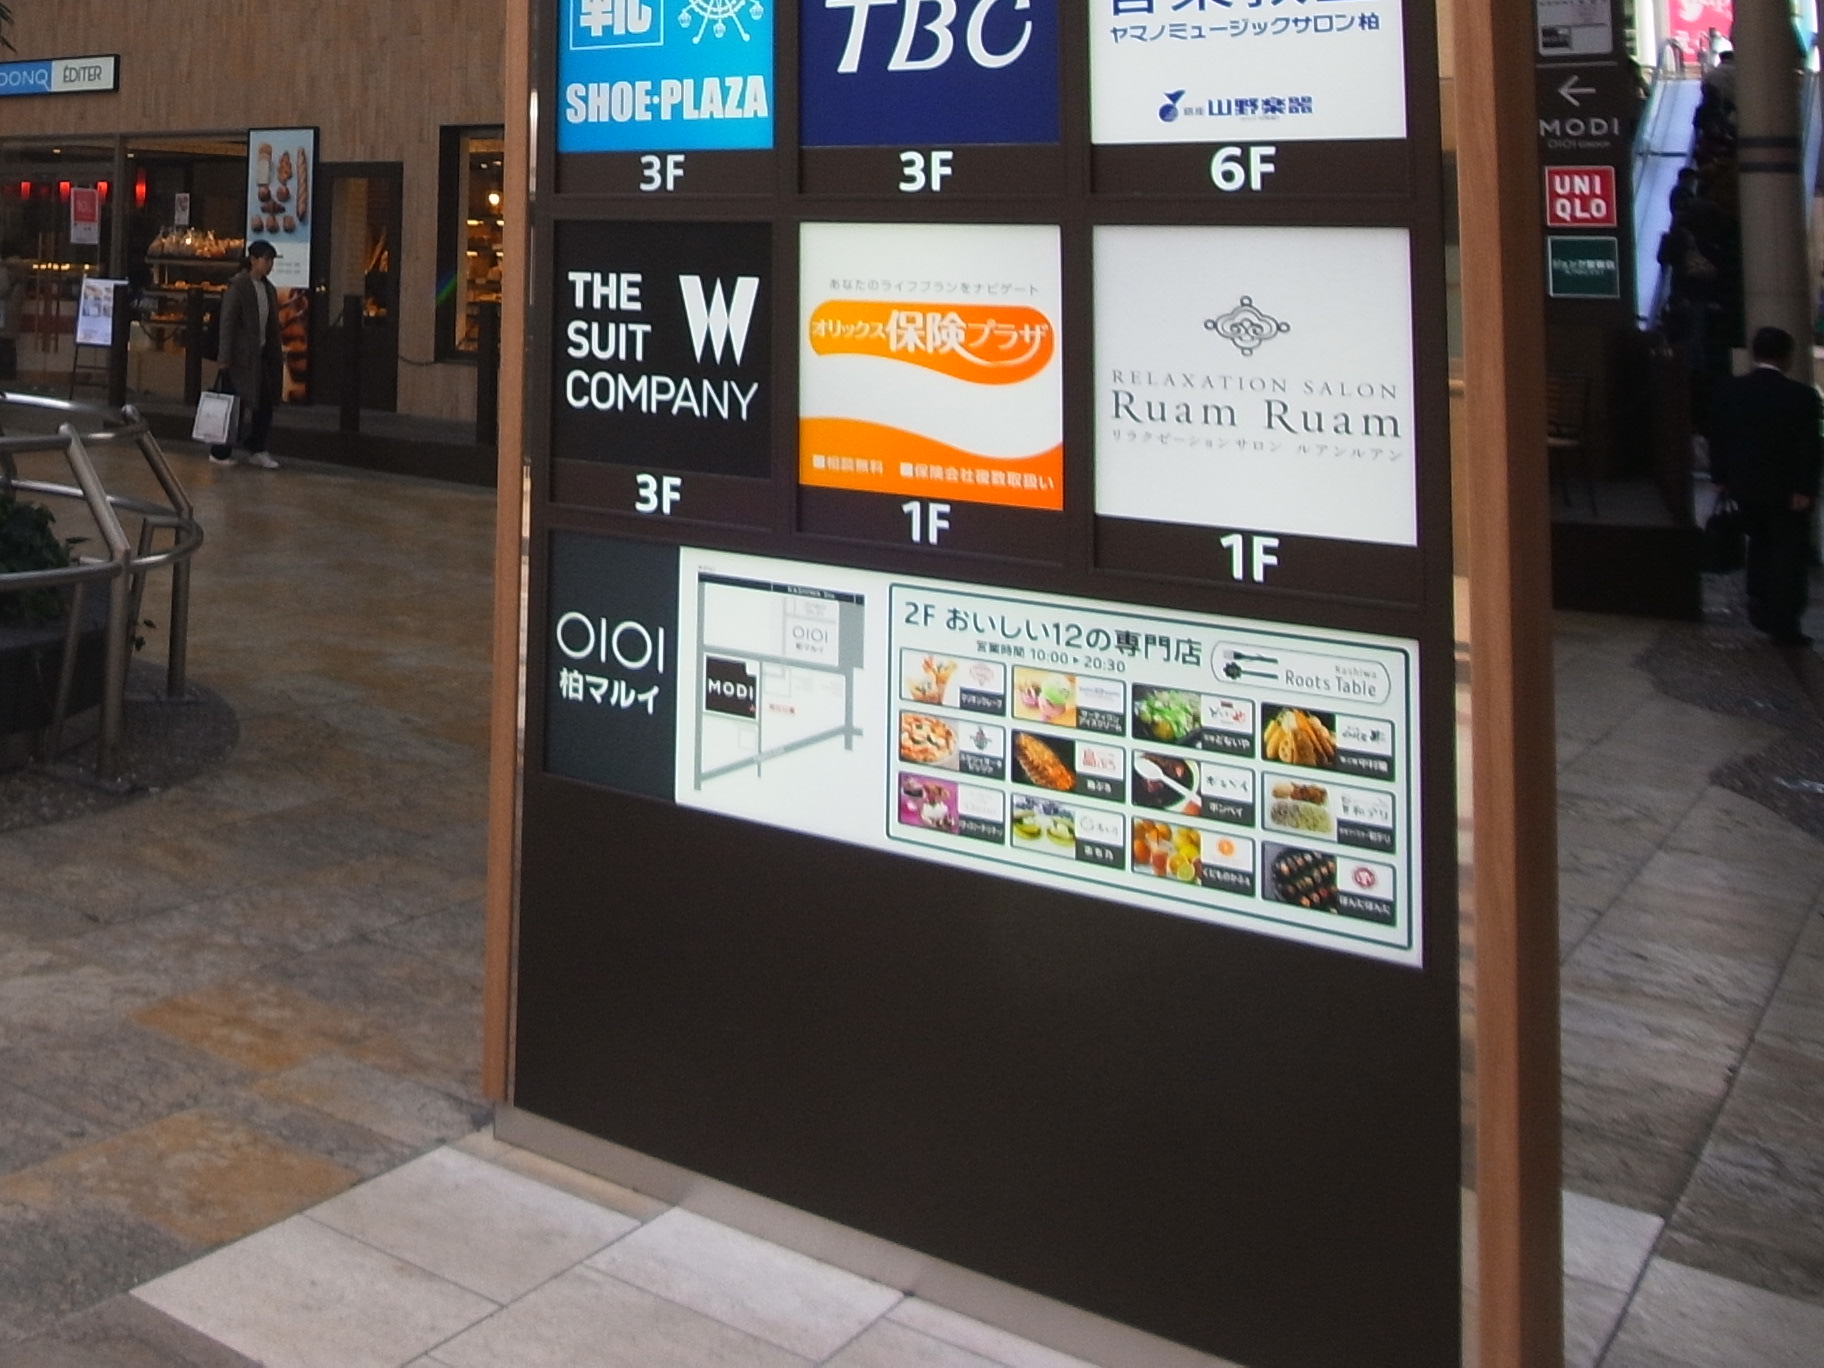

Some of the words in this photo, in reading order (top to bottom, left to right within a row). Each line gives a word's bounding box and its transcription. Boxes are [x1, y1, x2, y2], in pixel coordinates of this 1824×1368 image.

[1110, 11, 1381, 44] ヤマノミュージックサロン柏
[1539, 117, 1619, 137] MODI
[639, 153, 685, 192] 3F
[899, 150, 954, 193] 3F
[1210, 145, 1277, 192] 6F
[1554, 175, 1601, 195] UNI
[1554, 198, 1607, 222] QLO
[568, 271, 643, 312] THE
[828, 278, 1039, 297] あなたのライフプランをナビゲート
[566, 320, 652, 362] SUIT
[565, 370, 760, 422] COMPANY
[1112, 368, 1287, 394] RELAXATION
[1304, 380, 1398, 399] SALON
[1111, 389, 1238, 427] Ruam
[1264, 398, 1402, 439] Ruam
[1111, 428, 1281, 453] リラクゼーションサロン
[635, 473, 682, 516] 3F
[901, 500, 951, 545] 1F
[1220, 532, 1279, 582] 1F
[904, 601, 935, 628] 2F
[945, 607, 1202, 667] おいしい12の専門店
[559, 667, 659, 715] 柏マルイ
[707, 678, 754, 701] MODI
[1285, 668, 1331, 692] Roots
[1336, 675, 1377, 698] Table
